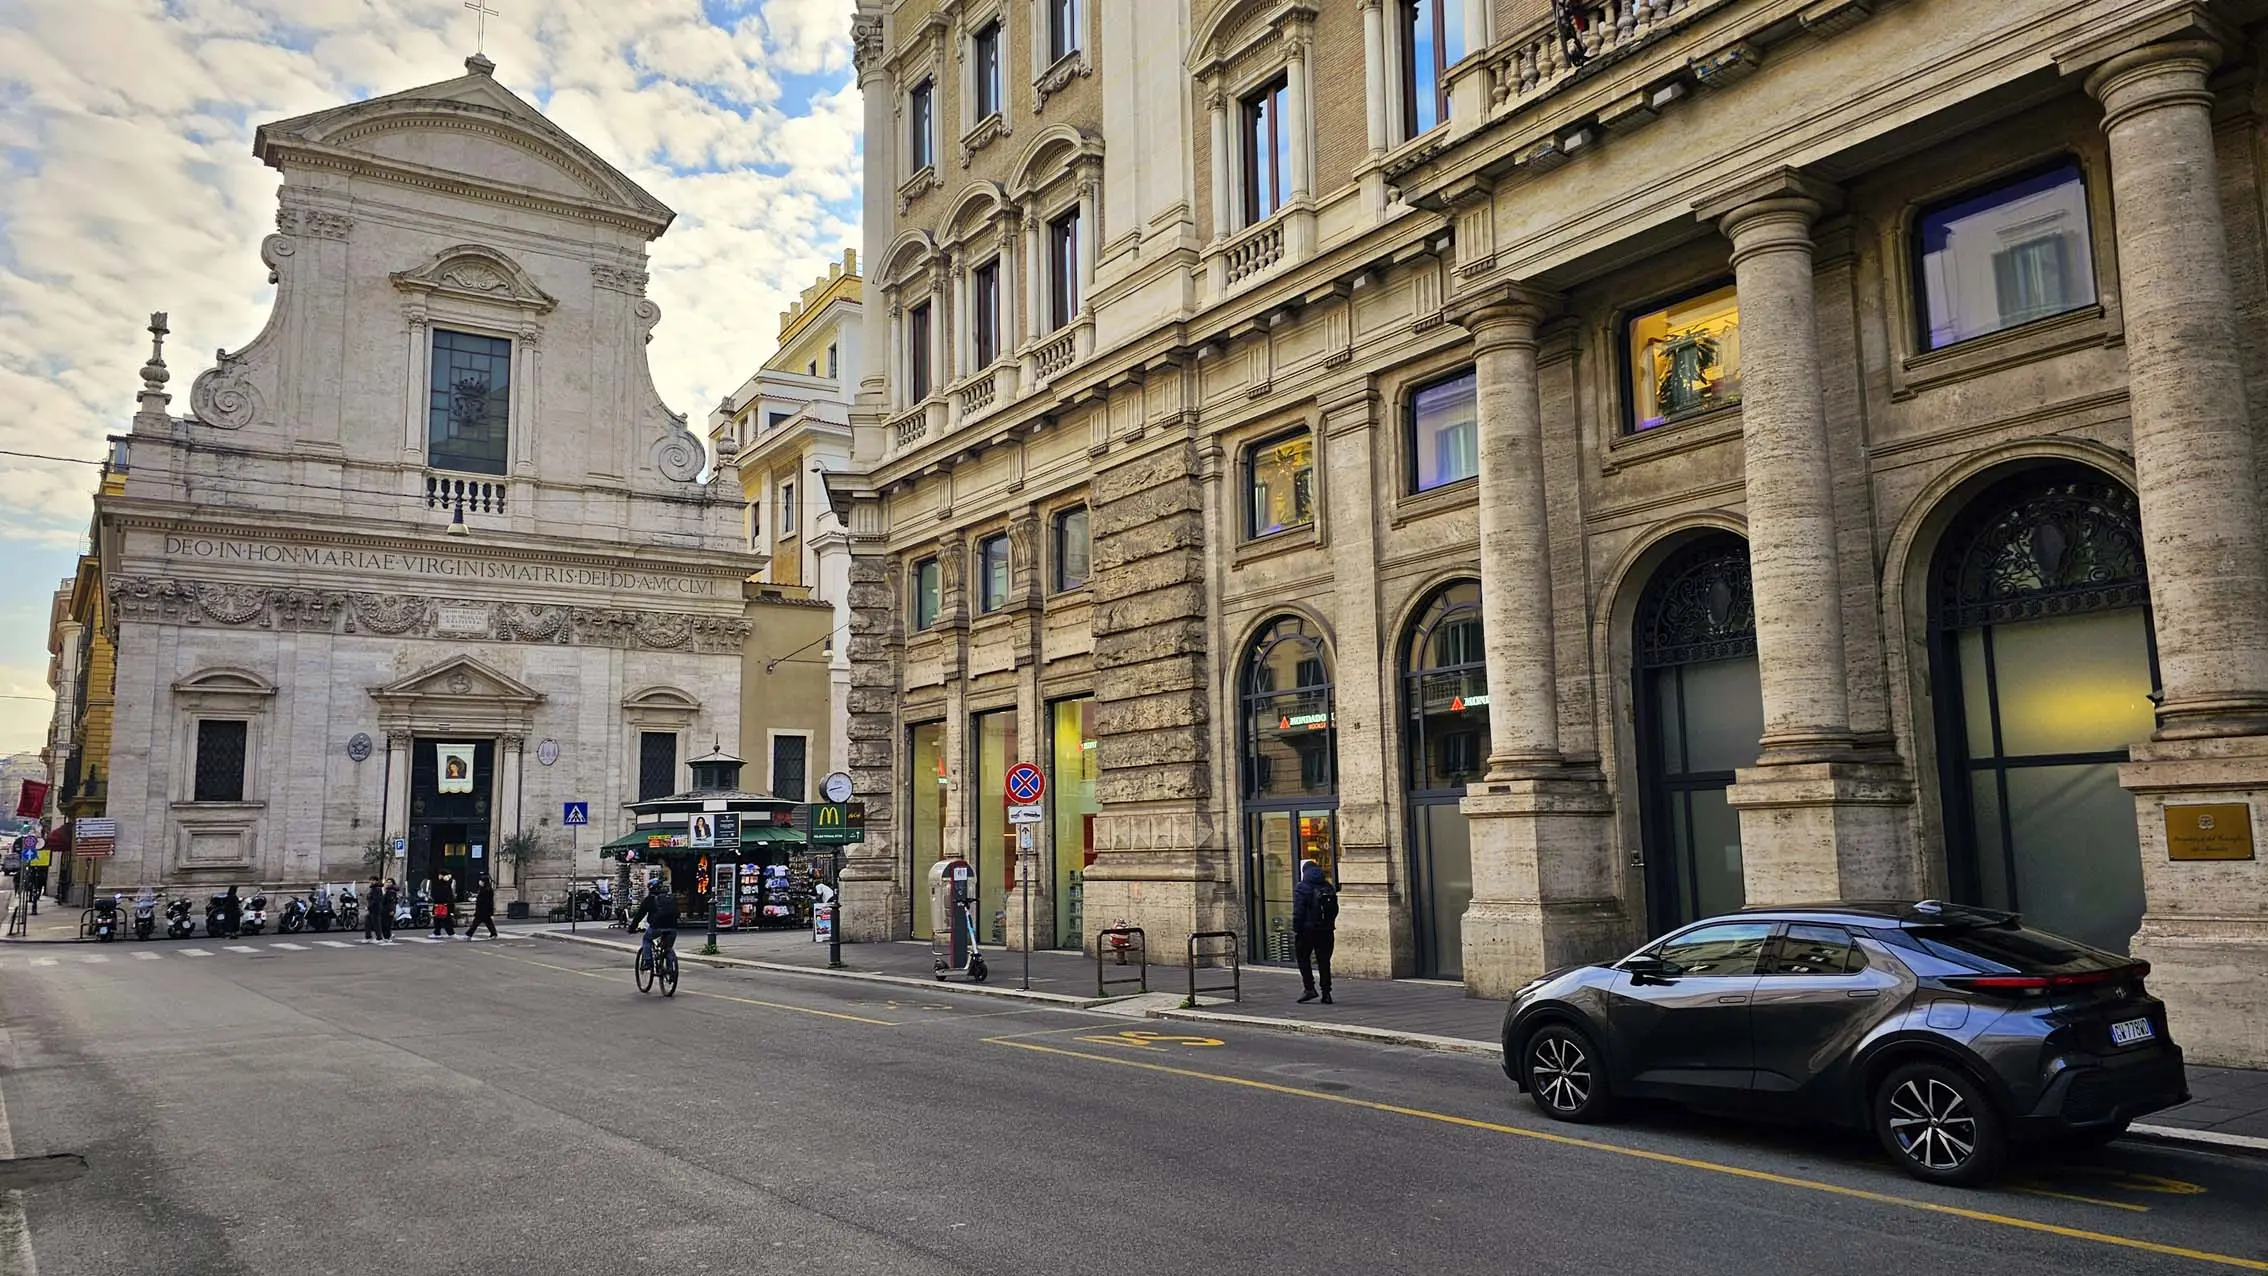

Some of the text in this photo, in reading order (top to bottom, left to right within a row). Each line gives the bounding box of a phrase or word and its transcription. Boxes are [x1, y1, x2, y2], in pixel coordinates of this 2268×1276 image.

[165, 537, 213, 557] DEO
[219, 541, 242, 558] IN
[248, 543, 298, 563] HON
[303, 548, 396, 571] MARIAE
[402, 555, 497, 578] VIRGINIS
[500, 563, 574, 584] MATRIS
[578, 569, 606, 587] DEI
